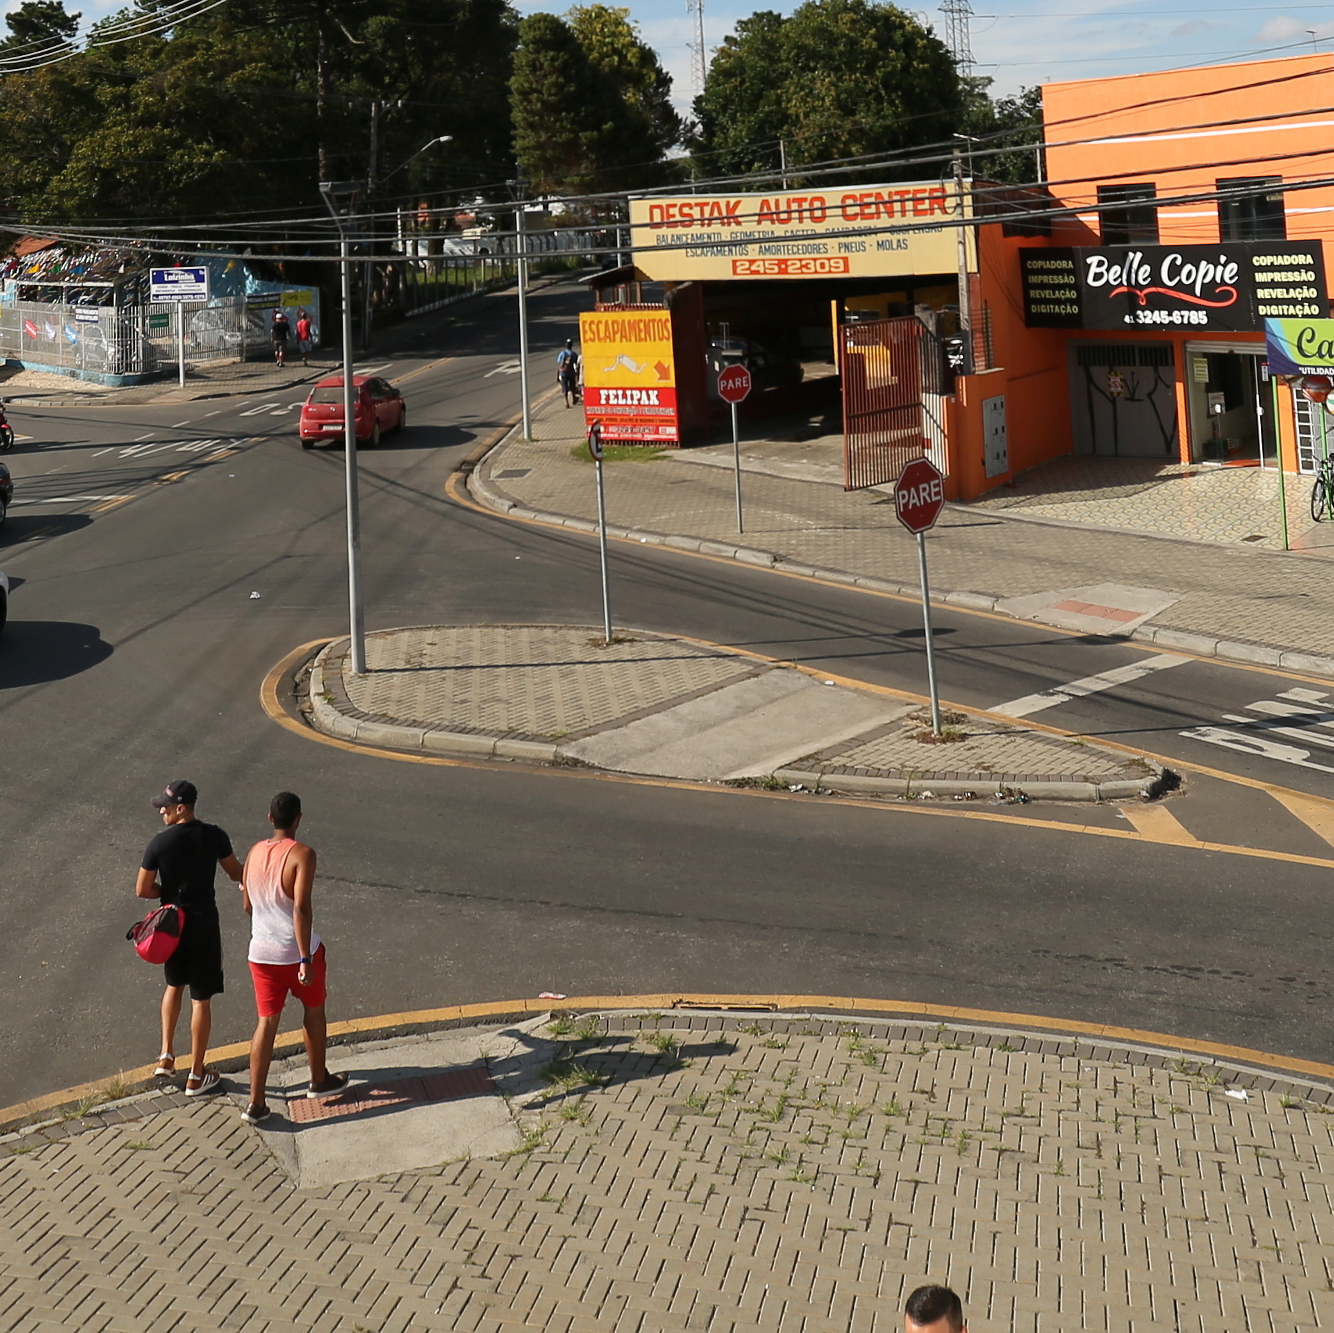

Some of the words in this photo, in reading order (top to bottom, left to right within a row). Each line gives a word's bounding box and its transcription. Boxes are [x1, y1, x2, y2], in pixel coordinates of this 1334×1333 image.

[649, 200, 742, 229] DESTAK
[757, 196, 826, 225] AUTO
[841, 187, 948, 221] CENTER
[656, 231, 722, 245] BALANCEAMENTO
[730, 229, 775, 242] GEOMETRIA
[686, 245, 748, 257] ESCAPAMENTOS
[758, 242, 828, 255] AMORTECEDORES
[838, 241, 866, 253] PNEUS
[877, 239, 908, 251] MOLAS
[1027, 260, 1074, 269] COPIADORA
[1252, 254, 1314, 266] COPIADORA
[1028, 274, 1075, 284] IMPRESSÃO
[1086, 251, 1151, 287] Belle
[1160, 253, 1238, 297] Copie
[1255, 269, 1316, 282] IMPRESSÃO
[1029, 289, 1077, 301] REVELAÇÃO
[1257, 286, 1317, 300] REVELAÇÃO
[1031, 303, 1079, 315] DIGITAÇÃO
[1258, 302, 1319, 317] DIGITAÇÃO
[1123, 314, 1135, 324] 41
[1135, 310, 1208, 324] 3245-6785
[581, 318, 671, 343] ESCAPAMENTOS
[720, 376, 749, 391] PARE
[599, 389, 660, 405] FELIPAK
[898, 479, 942, 513] PARE
